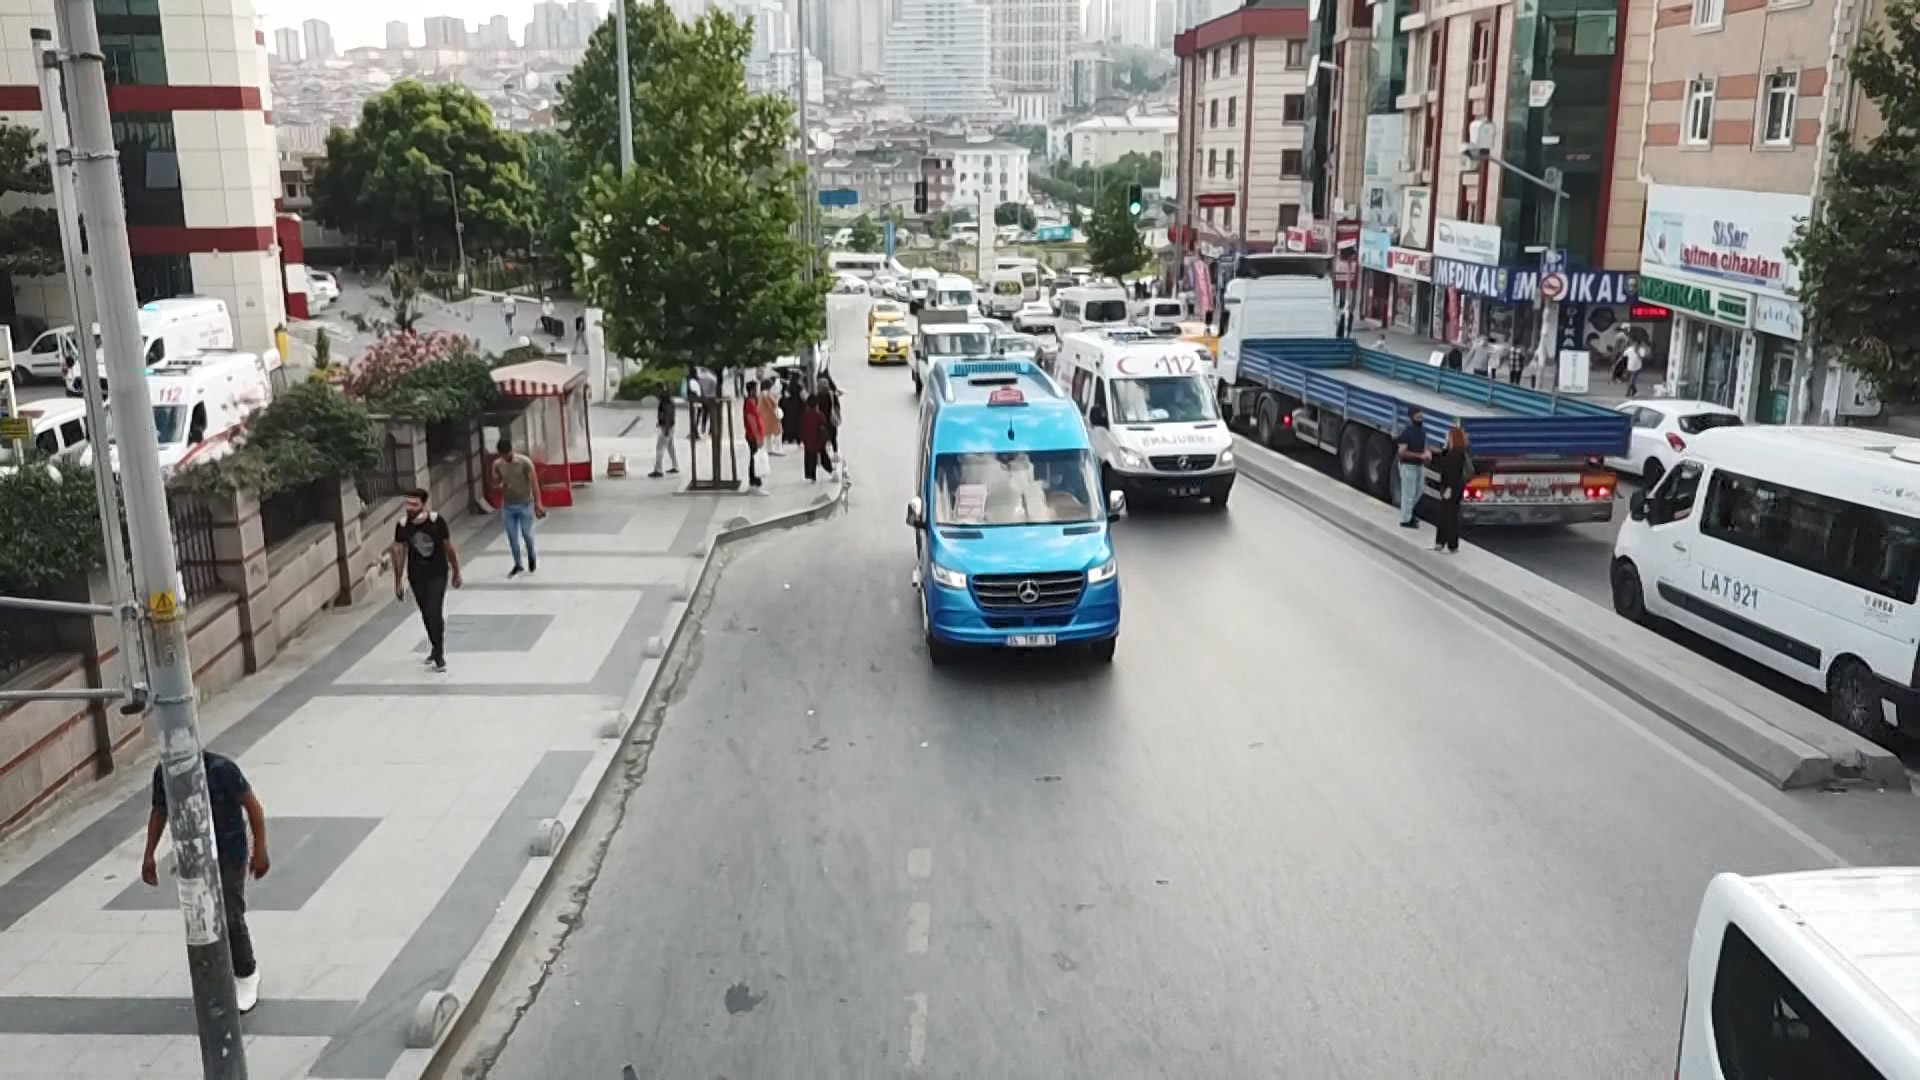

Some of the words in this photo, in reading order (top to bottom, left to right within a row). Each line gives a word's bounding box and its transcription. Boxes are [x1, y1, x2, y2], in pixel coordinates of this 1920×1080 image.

[1517, 271, 1627, 302] MDIKAL
[1159, 355, 1197, 375] 112
[159, 387, 182, 403] 112
[1701, 568, 1759, 610] LAT921
